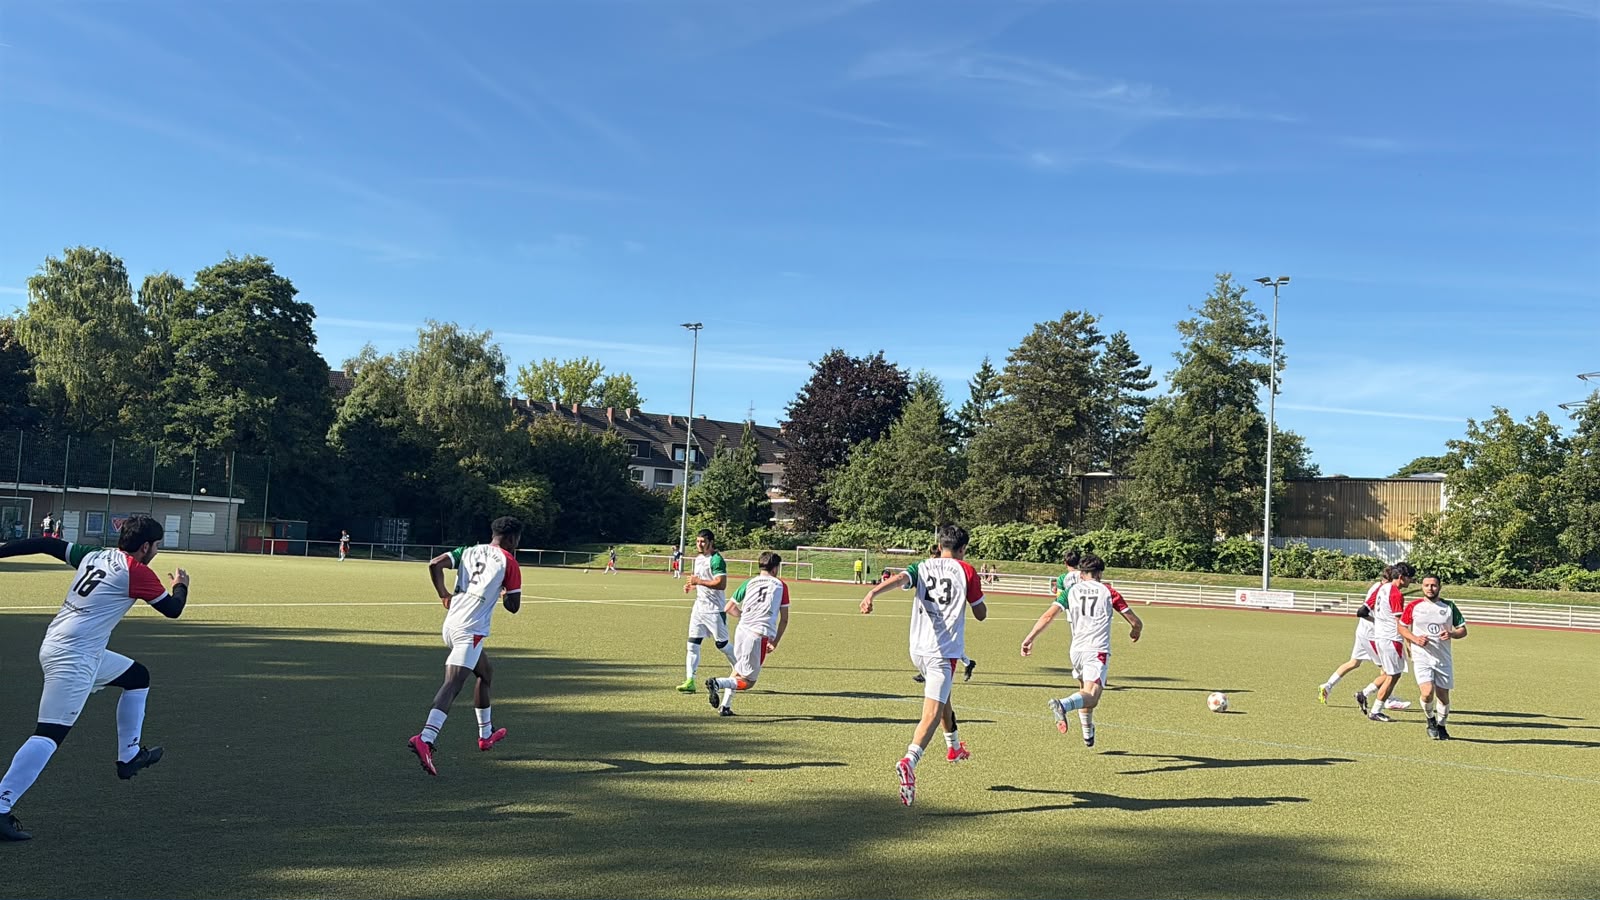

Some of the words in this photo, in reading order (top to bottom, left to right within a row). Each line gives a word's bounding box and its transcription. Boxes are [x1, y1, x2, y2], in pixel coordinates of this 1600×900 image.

[73, 565, 107, 597] 16
[468, 562, 486, 585] 2
[757, 586, 768, 603] 5
[925, 575, 952, 605] 23
[1080, 596, 1099, 617] 17
